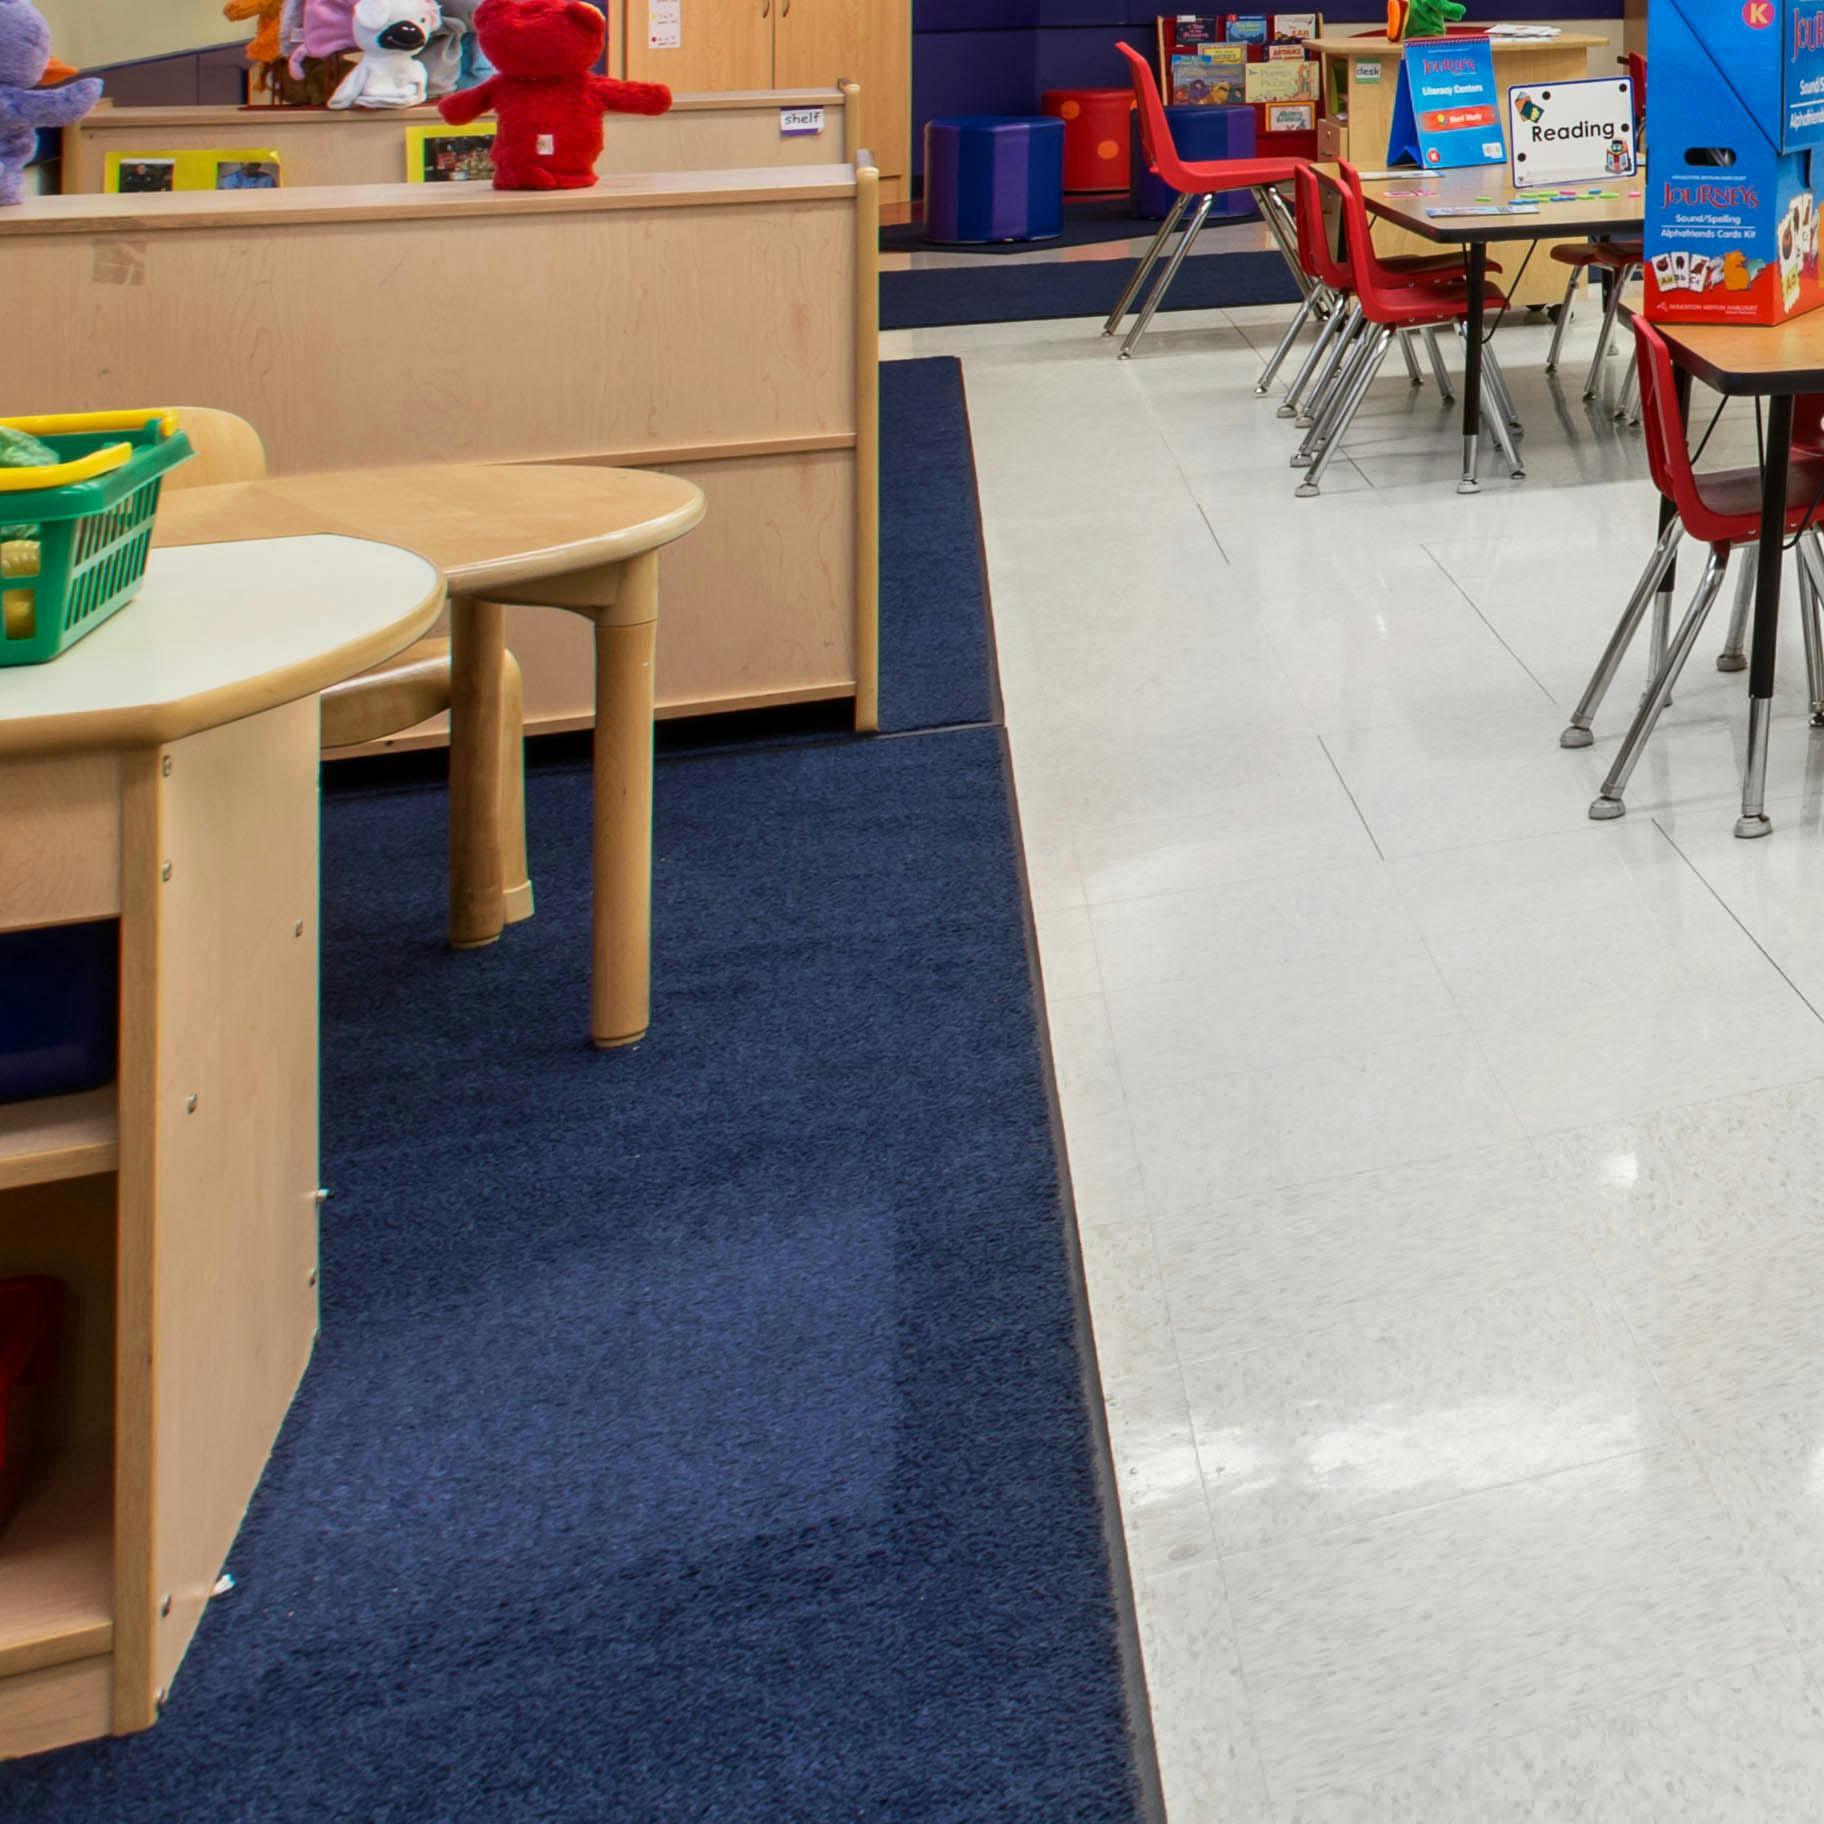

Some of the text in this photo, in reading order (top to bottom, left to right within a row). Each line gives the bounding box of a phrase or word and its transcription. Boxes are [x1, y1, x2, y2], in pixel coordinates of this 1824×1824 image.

[1751, 2, 1768, 24] K
[1356, 65, 1380, 76] desk
[784, 111, 820, 125] shelf
[1531, 120, 1616, 143] Reading
[1661, 182, 1760, 209] JOURNEYS
[1675, 213, 1742, 226] Sound/Spelling
[1660, 227, 1756, 240] Alphafriends Cards Kit
